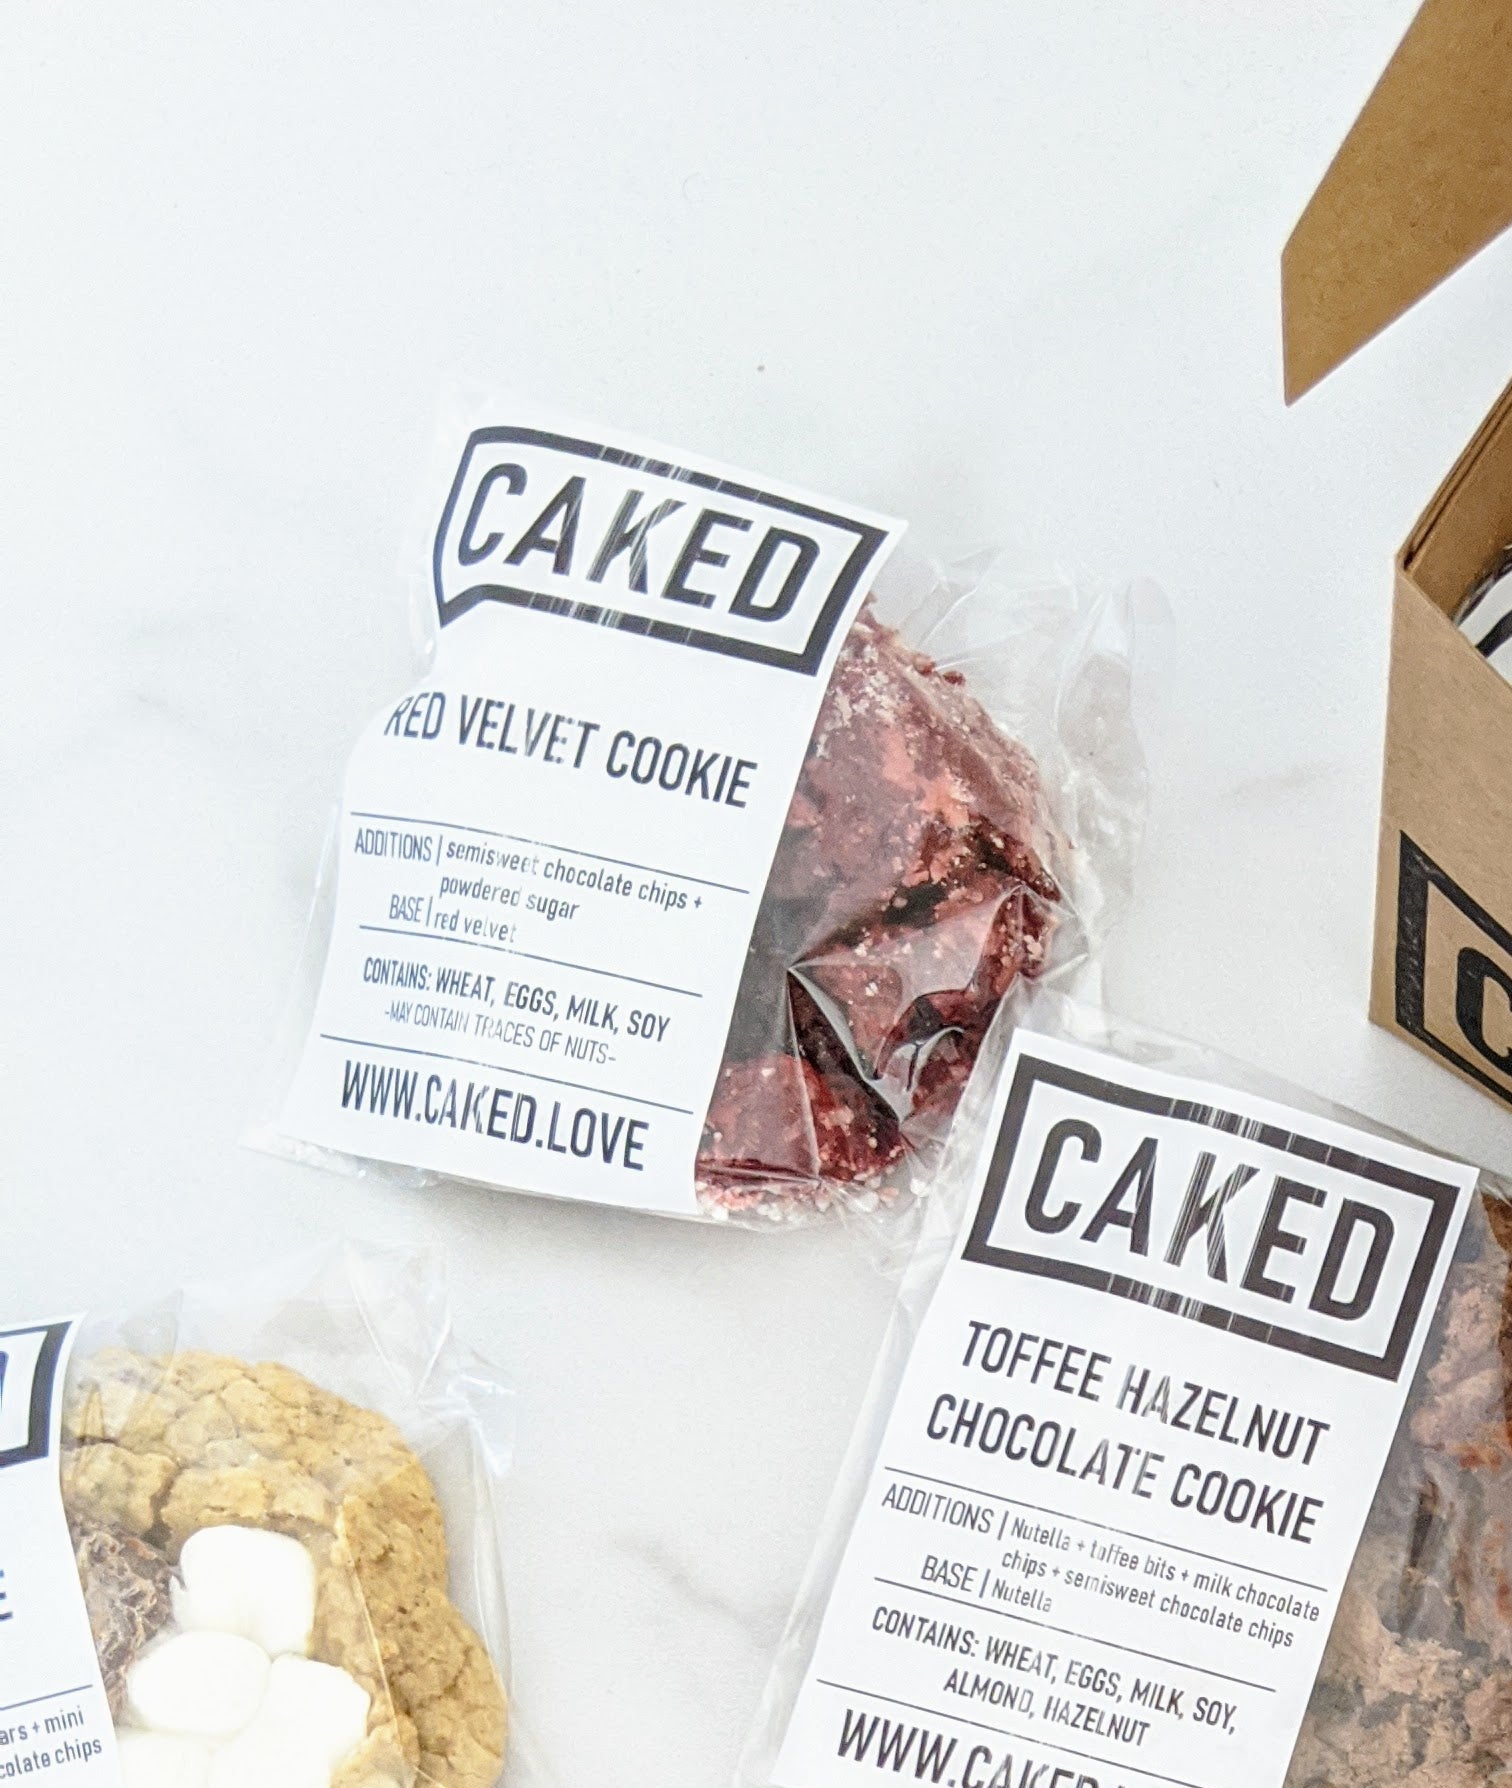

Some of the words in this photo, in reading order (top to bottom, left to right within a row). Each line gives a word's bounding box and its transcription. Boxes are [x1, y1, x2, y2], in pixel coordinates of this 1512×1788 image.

[457, 463, 822, 622] CAKED
[384, 691, 446, 740] RED
[458, 694, 600, 769] VELVET
[606, 730, 758, 808] COOKIE
[354, 828, 432, 862] ADDITIONS
[543, 858, 632, 896] chocolate
[638, 880, 687, 911] chips
[389, 894, 424, 922] BASE
[434, 909, 460, 931] red
[439, 876, 520, 906] powdered
[525, 894, 580, 921] sugar
[363, 956, 432, 990] CONTAINS:
[435, 967, 496, 1007] WHEAT,
[503, 981, 559, 1022] EGGS,
[566, 995, 618, 1035] MILK,
[626, 1009, 670, 1042] SOY
[341, 1060, 649, 1171] WWW.CAKED.LOVE
[1025, 1118, 1398, 1321] CAKED
[962, 1320, 1112, 1402] TOFFEE
[1116, 1364, 1330, 1465] HAZELNUT
[926, 1393, 1165, 1499] CHOCOLATE
[1170, 1463, 1324, 1544] COOKIE
[881, 1483, 994, 1533] ADDITIONS
[1010, 1517, 1070, 1550] Nutella
[1143, 1555, 1176, 1580] bits
[1193, 1572, 1232, 1597] milk
[1235, 1583, 1319, 1621] chocolate
[920, 1554, 978, 1592] BASE
[991, 1578, 1052, 1612] Nutella
[1001, 1549, 1047, 1578] chips
[1064, 1570, 1155, 1608] semisweet
[1159, 1594, 1243, 1632] chocolate
[1248, 1619, 1294, 1648] chips
[44, 1705, 84, 1733] mini
[872, 1606, 979, 1657] CONTAINS:
[984, 1635, 1058, 1684] WHEAT,
[1064, 1659, 1122, 1703] EGGS,
[1129, 1678, 1184, 1720] MILK,
[1192, 1696, 1237, 1735] SOY,
[942, 1668, 1034, 1719] ALMOND,
[1042, 1695, 1151, 1746] HAZELNUT
[54, 1738, 102, 1764] chips
